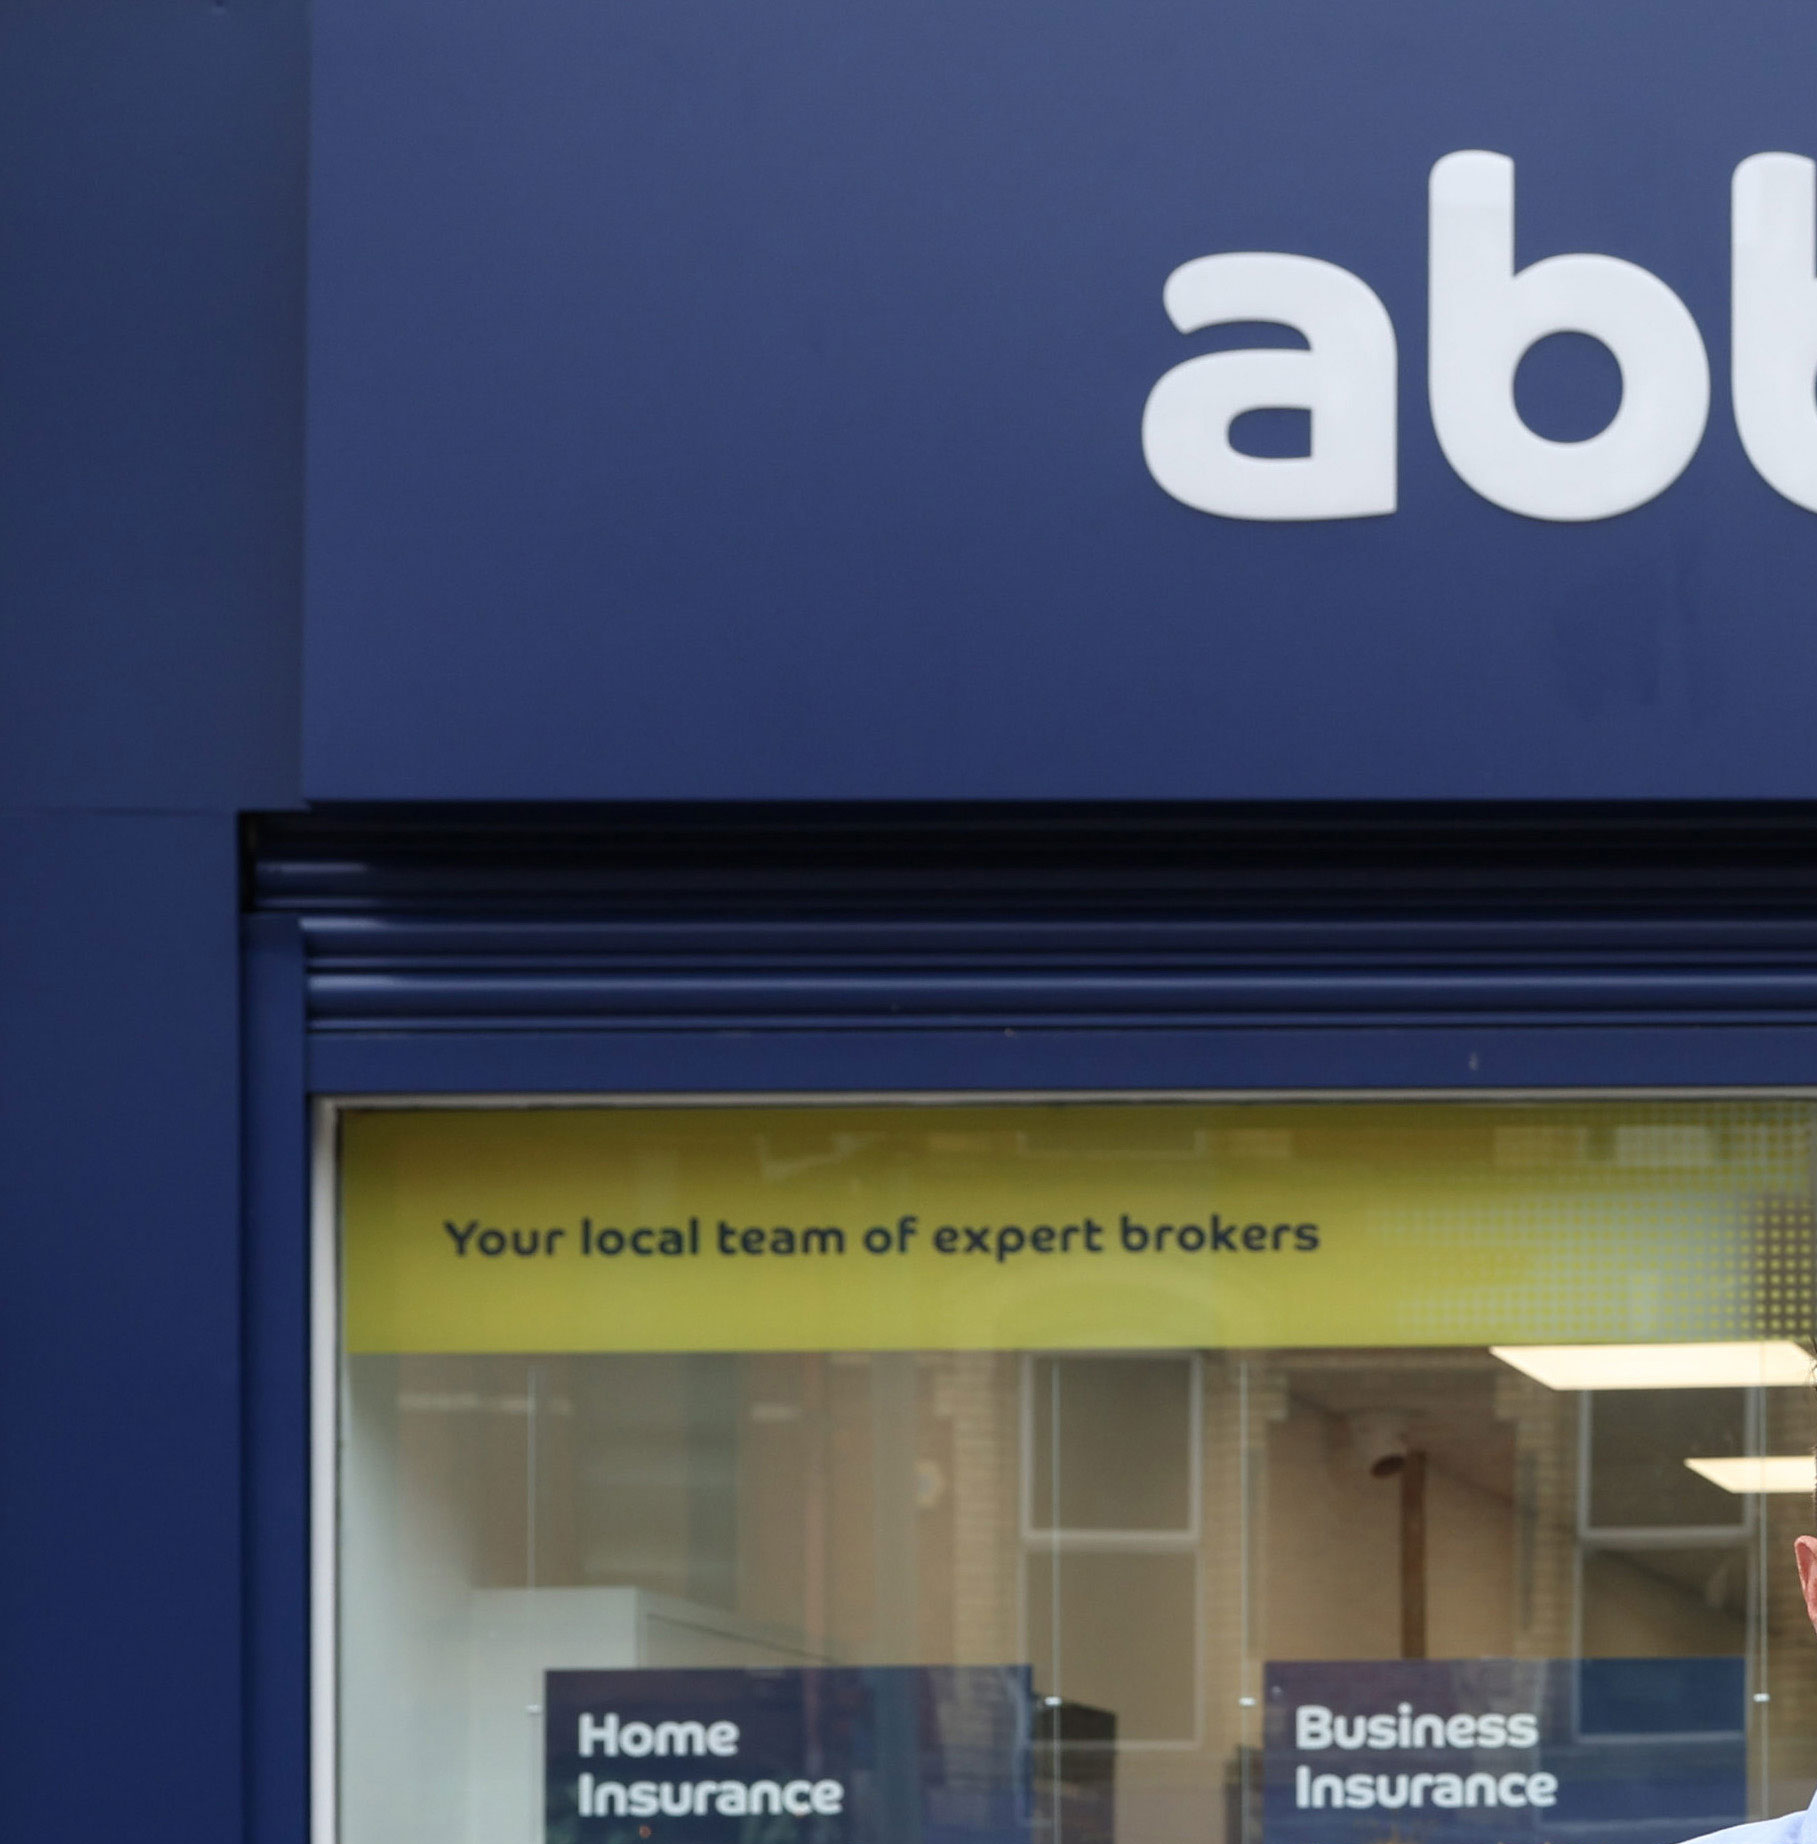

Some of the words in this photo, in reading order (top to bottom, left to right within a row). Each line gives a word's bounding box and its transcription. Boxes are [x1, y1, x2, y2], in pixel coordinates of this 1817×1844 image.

[444, 1219, 565, 1257] Your
[580, 1216, 700, 1256] local
[717, 1220, 845, 1256] team
[863, 1217, 917, 1255] of
[933, 1219, 1102, 1262] expert
[1120, 1214, 1321, 1252] brokers
[578, 1712, 740, 1757] Home
[1296, 1703, 1539, 1749] Business
[578, 1773, 844, 1817] Insurance
[1296, 1765, 1558, 1809] Insurance
